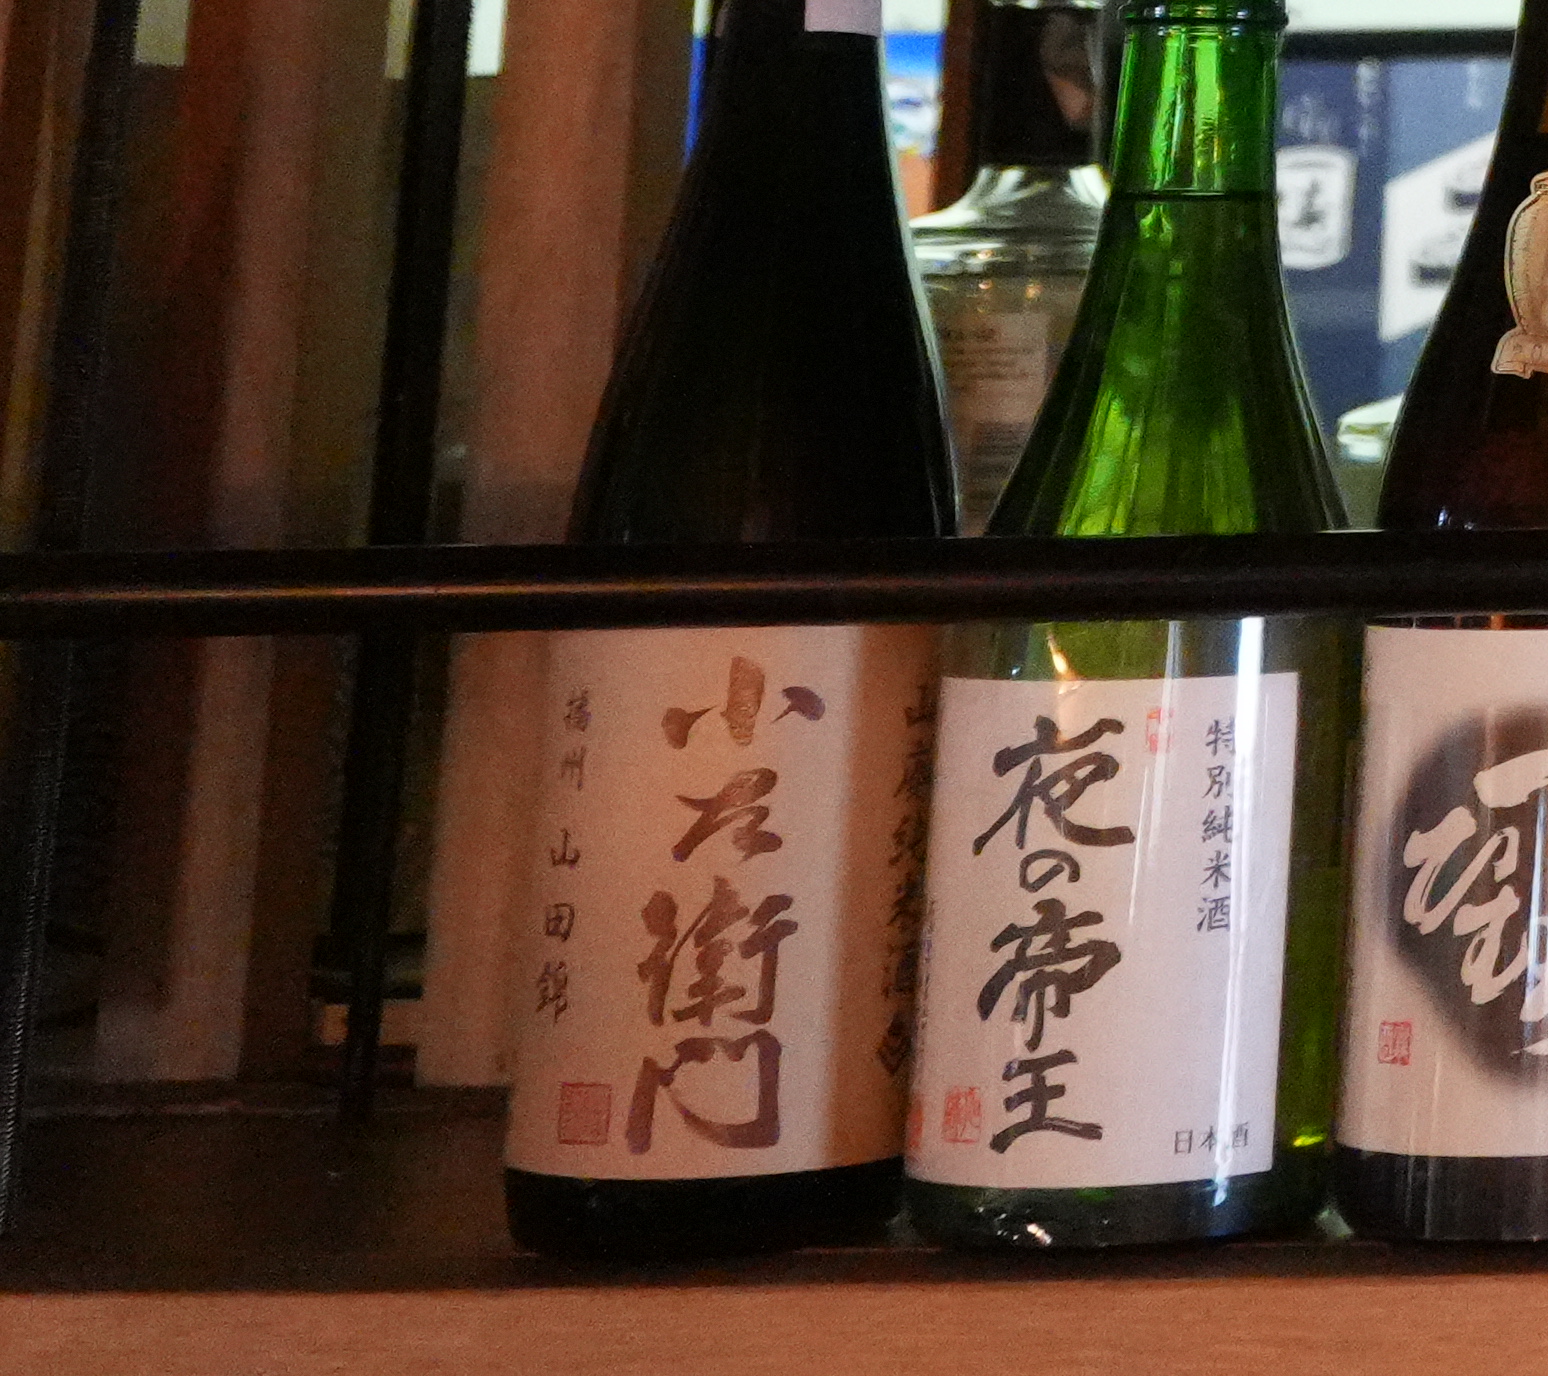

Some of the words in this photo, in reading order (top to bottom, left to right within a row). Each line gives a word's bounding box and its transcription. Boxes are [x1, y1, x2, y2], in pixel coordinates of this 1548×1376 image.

[533, 828, 582, 1022] 山田錦
[1196, 716, 1237, 934] 特別純米酒
[973, 714, 1137, 1156] 夜の帝王
[1173, 1121, 1251, 1156] 日本酒
